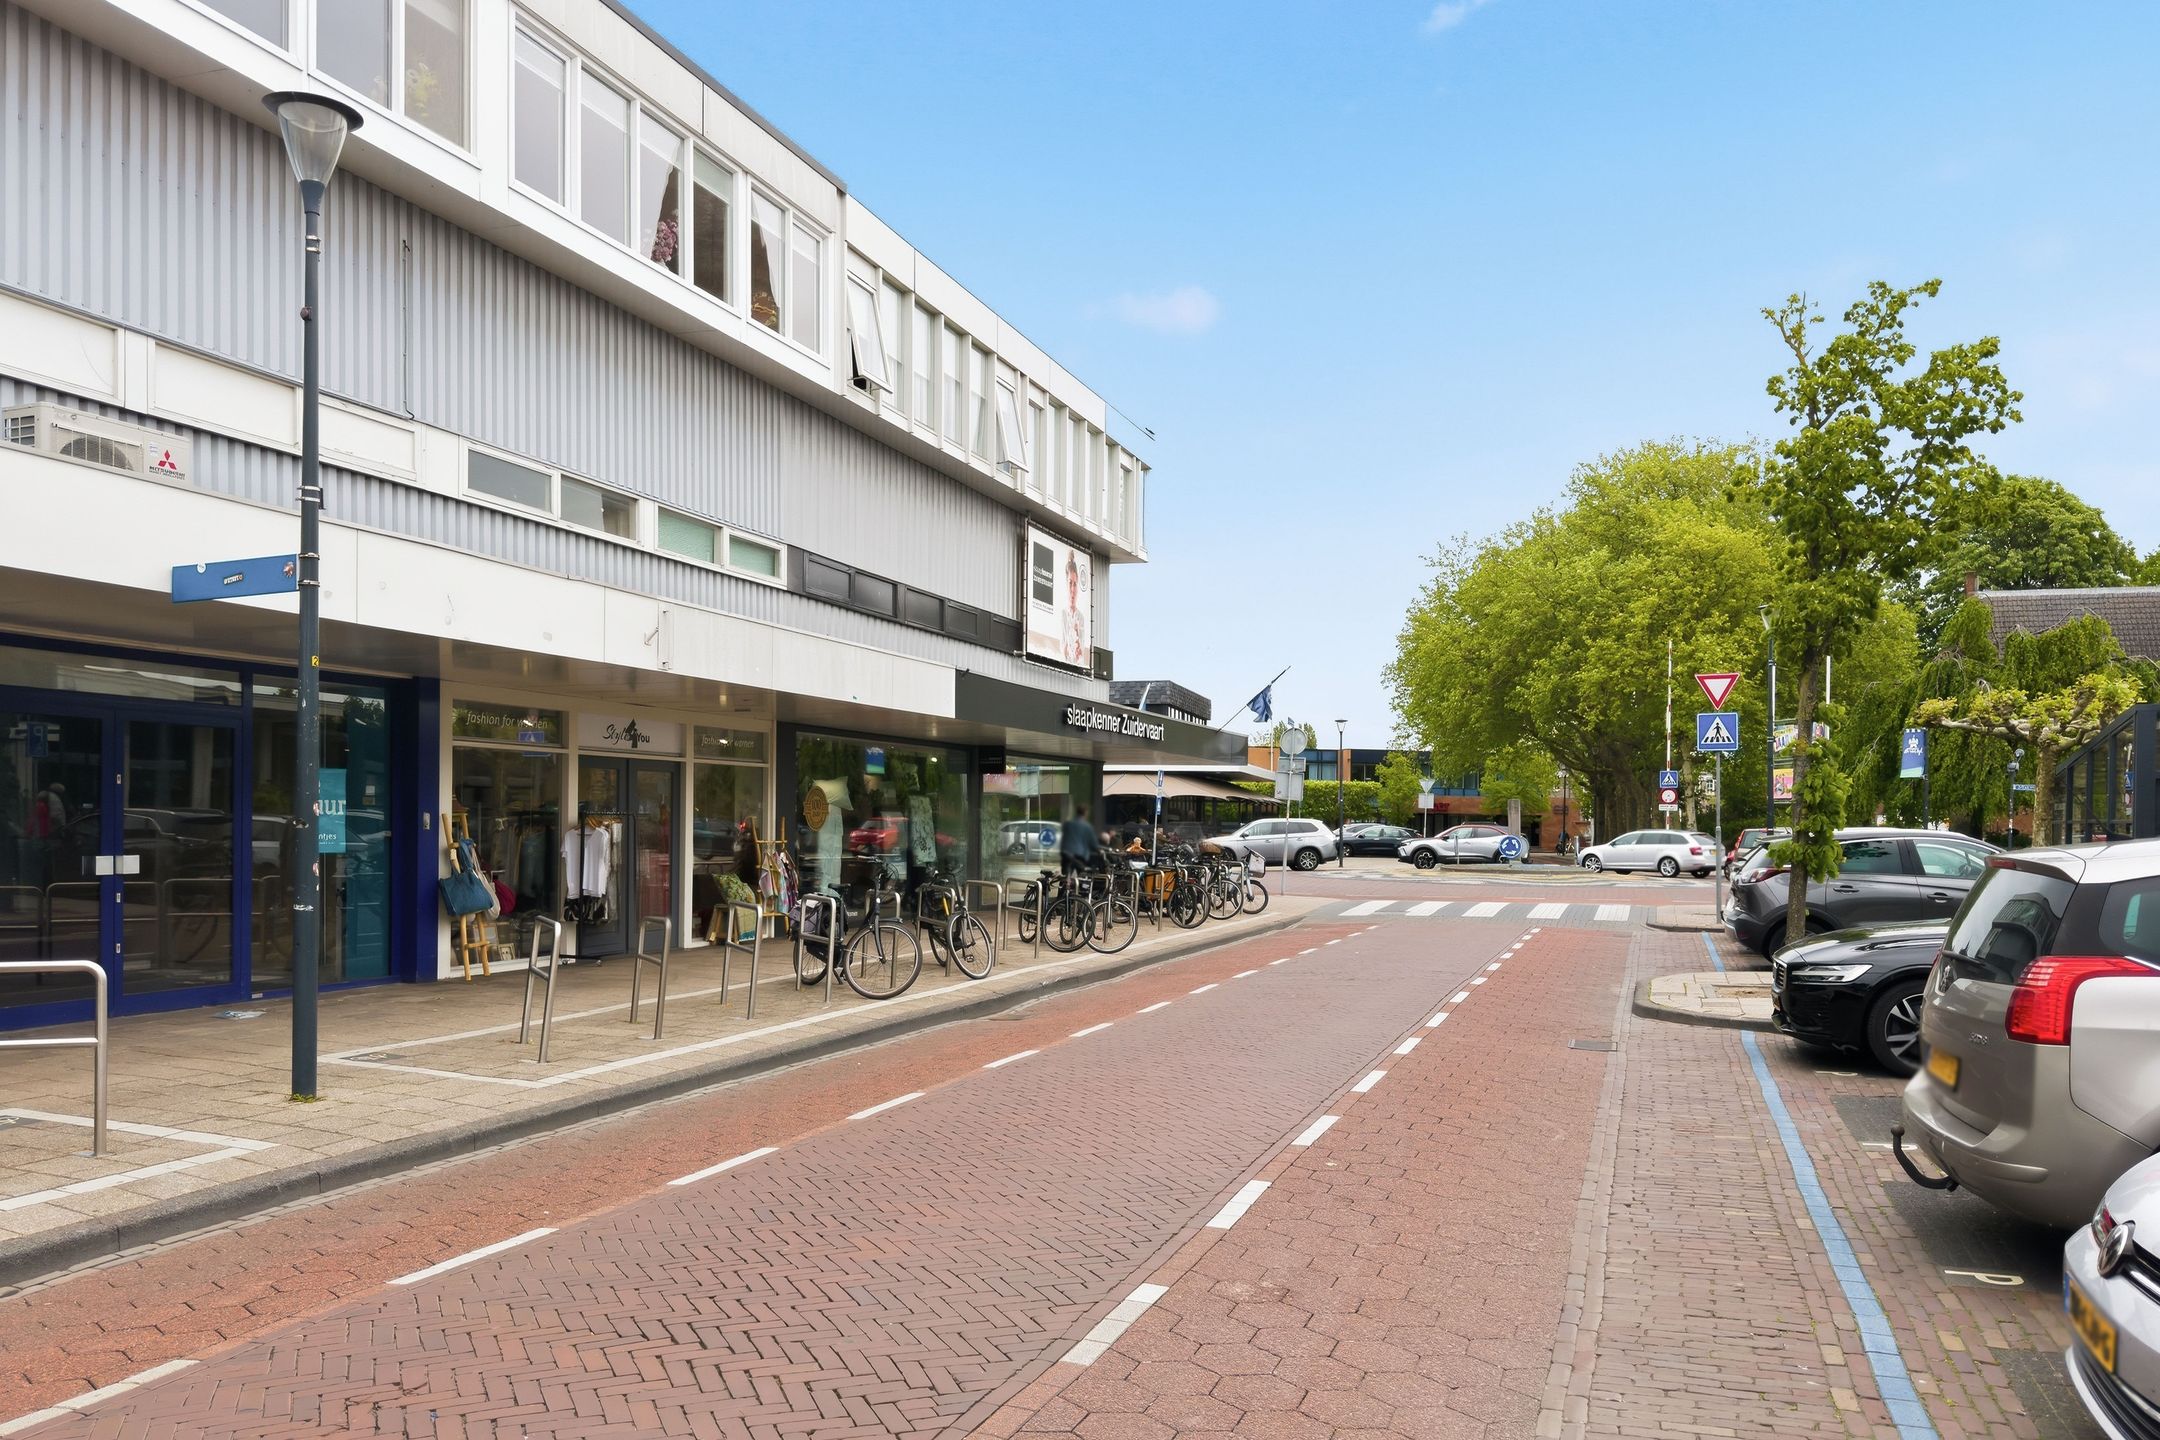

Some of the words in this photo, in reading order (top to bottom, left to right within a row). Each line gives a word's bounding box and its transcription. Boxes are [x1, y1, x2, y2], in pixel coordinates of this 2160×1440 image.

[466, 709, 500, 726] fashion
[501, 714, 517, 728] for
[517, 719, 548, 729] wen
[1067, 703, 1120, 732] slaapkenner
[1122, 713, 1164, 740] Zuidervaart
